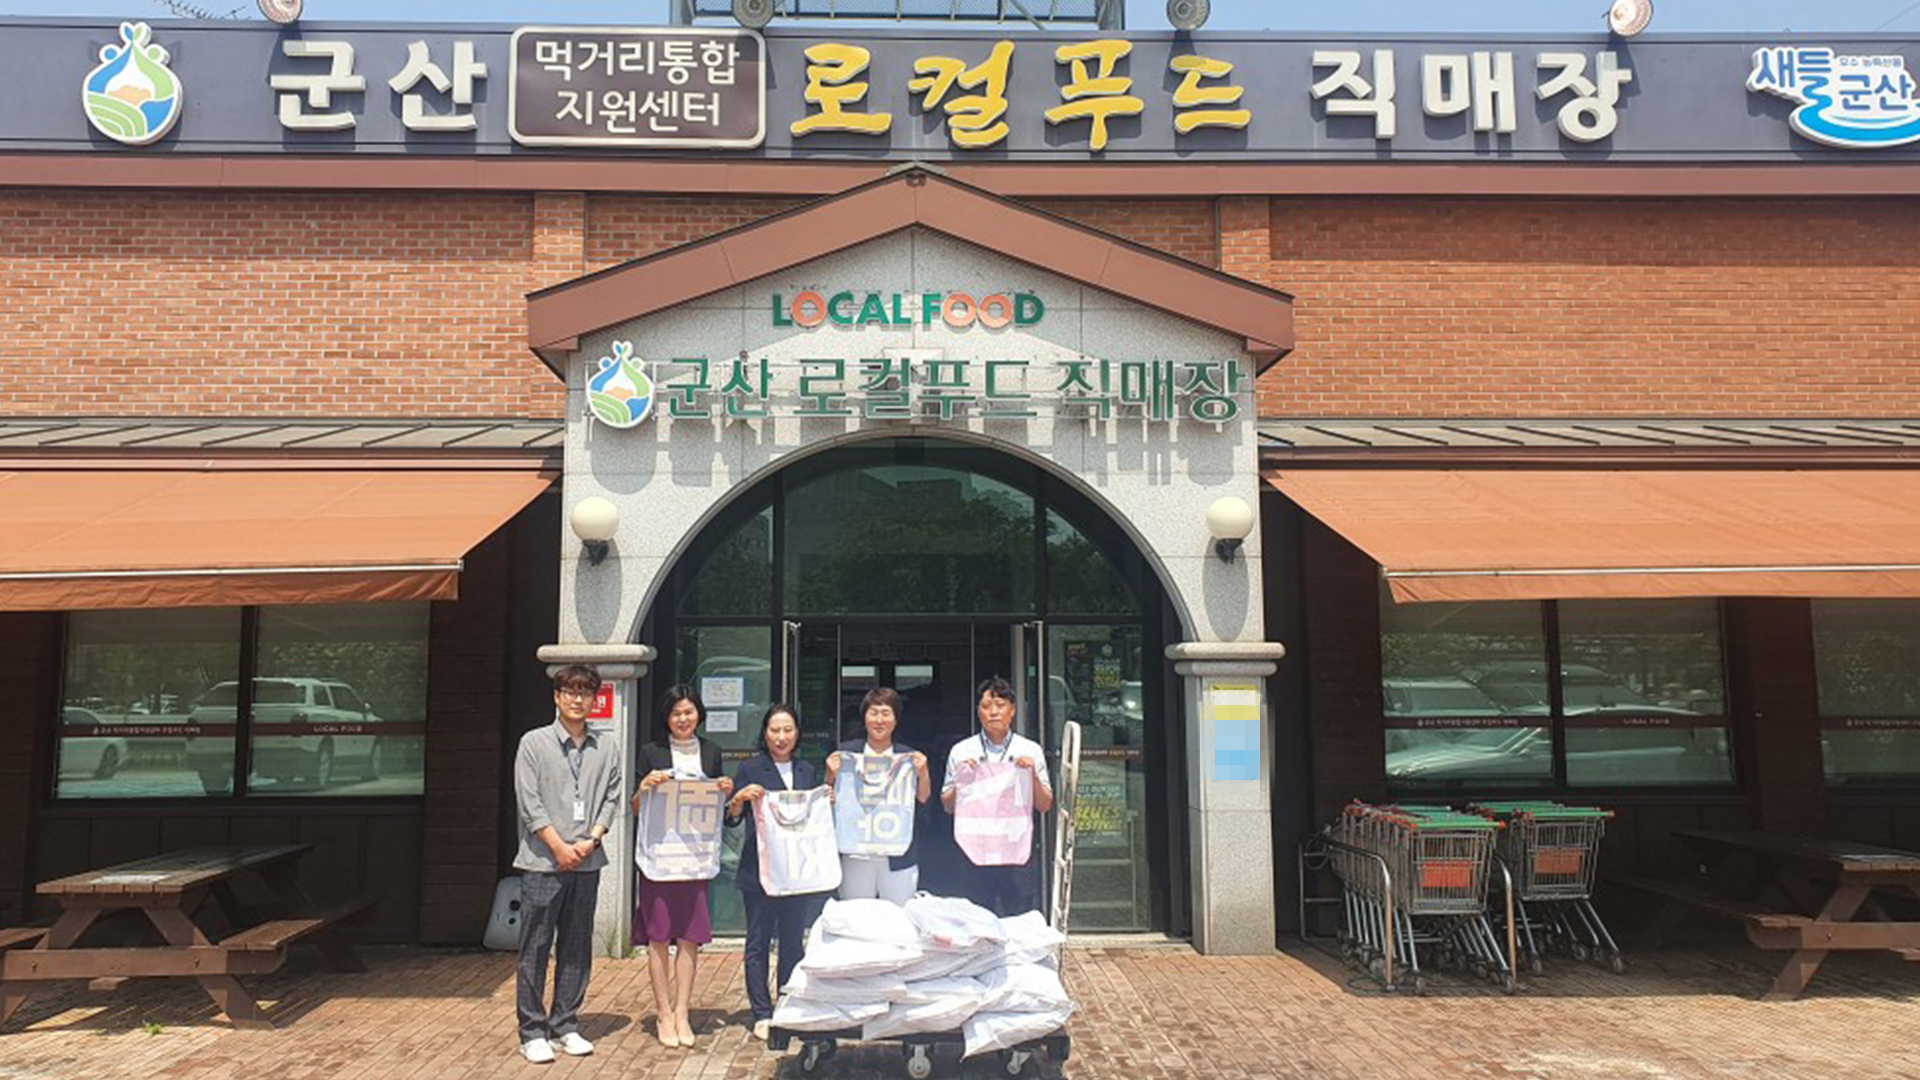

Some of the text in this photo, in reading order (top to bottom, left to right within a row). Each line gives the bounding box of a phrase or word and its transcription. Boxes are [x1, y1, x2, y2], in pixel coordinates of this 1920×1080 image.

[534, 40, 740, 85] 먹거리통합
[270, 40, 1633, 150] 군산 로컬푸드 직매장
[555, 90, 722, 133] 지원센터
[1838, 74, 1912, 111] 군산
[772, 291, 1045, 328] LOCAL FOOD
[666, 356, 1247, 422] 군산 로컬푸드 직매장
